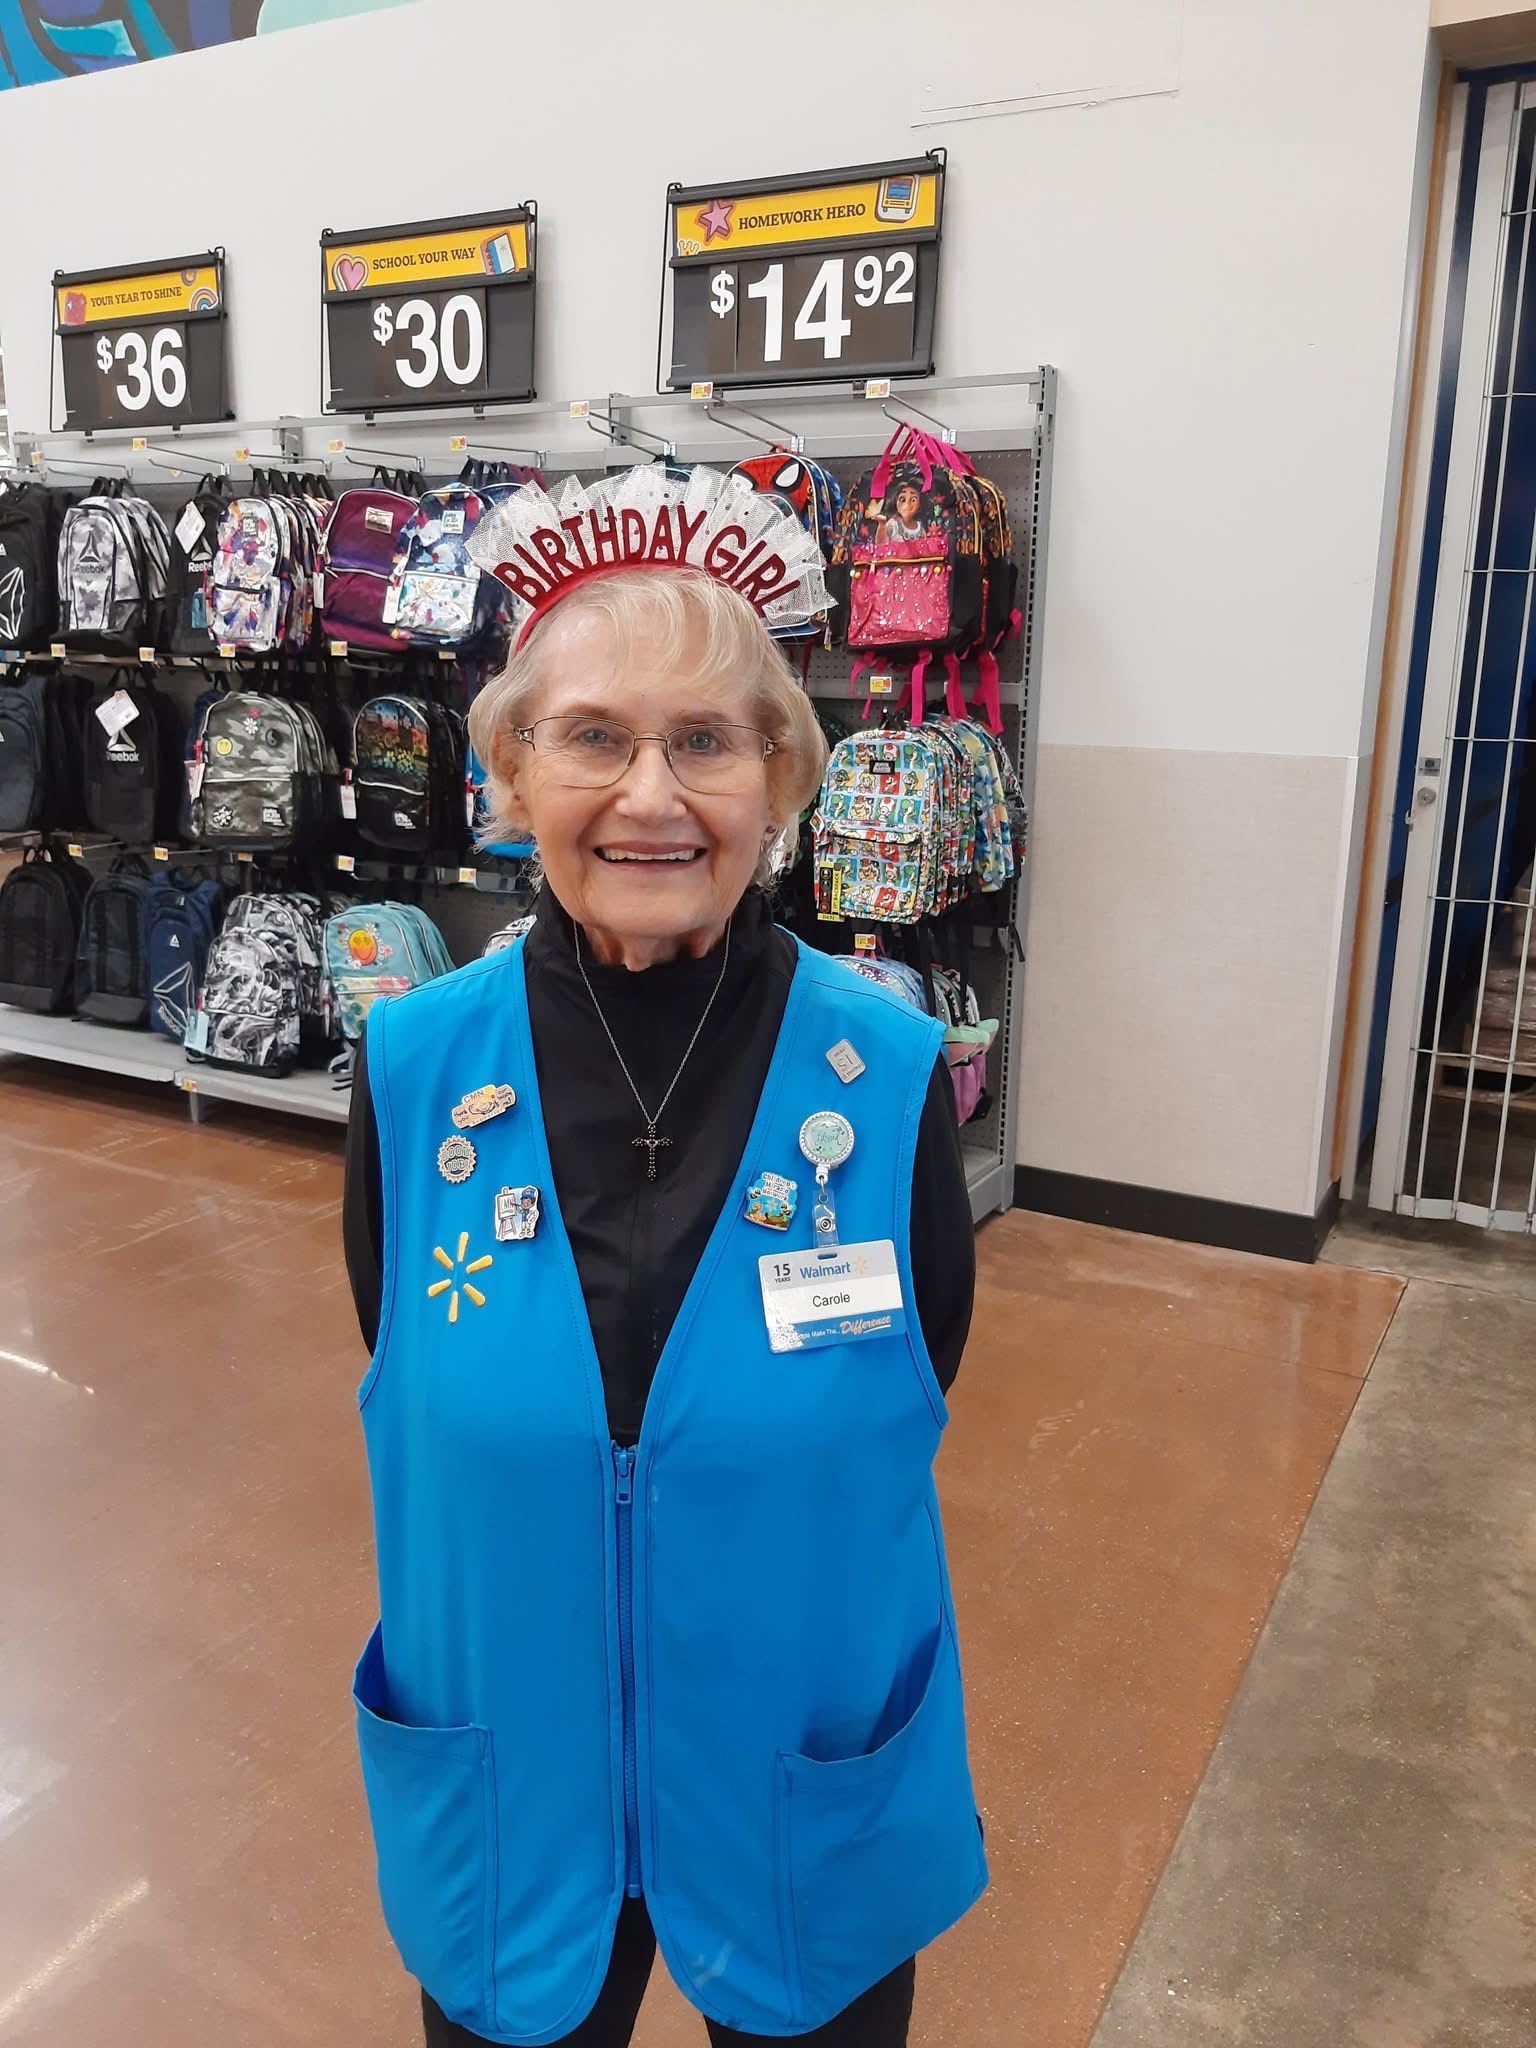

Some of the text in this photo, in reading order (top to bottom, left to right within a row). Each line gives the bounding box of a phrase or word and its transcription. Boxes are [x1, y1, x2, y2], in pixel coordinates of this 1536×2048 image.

[738, 203, 866, 230] HOMEWORK HERO
[372, 247, 476, 270] SCHOOL YOUR WAY
[90, 286, 183, 308] YOUR YEAR TO SHINE
[188, 560, 212, 573] Reeb
[493, 504, 801, 619] BIRTHDAY GIRL
[463, 1089, 484, 1103] CMN
[773, 1263, 792, 1277] 15
[800, 1261, 852, 1280] Walmart
[812, 1292, 851, 1308] Carole
[811, 1329, 827, 1338] Make
[840, 1314, 892, 1336] Difference
